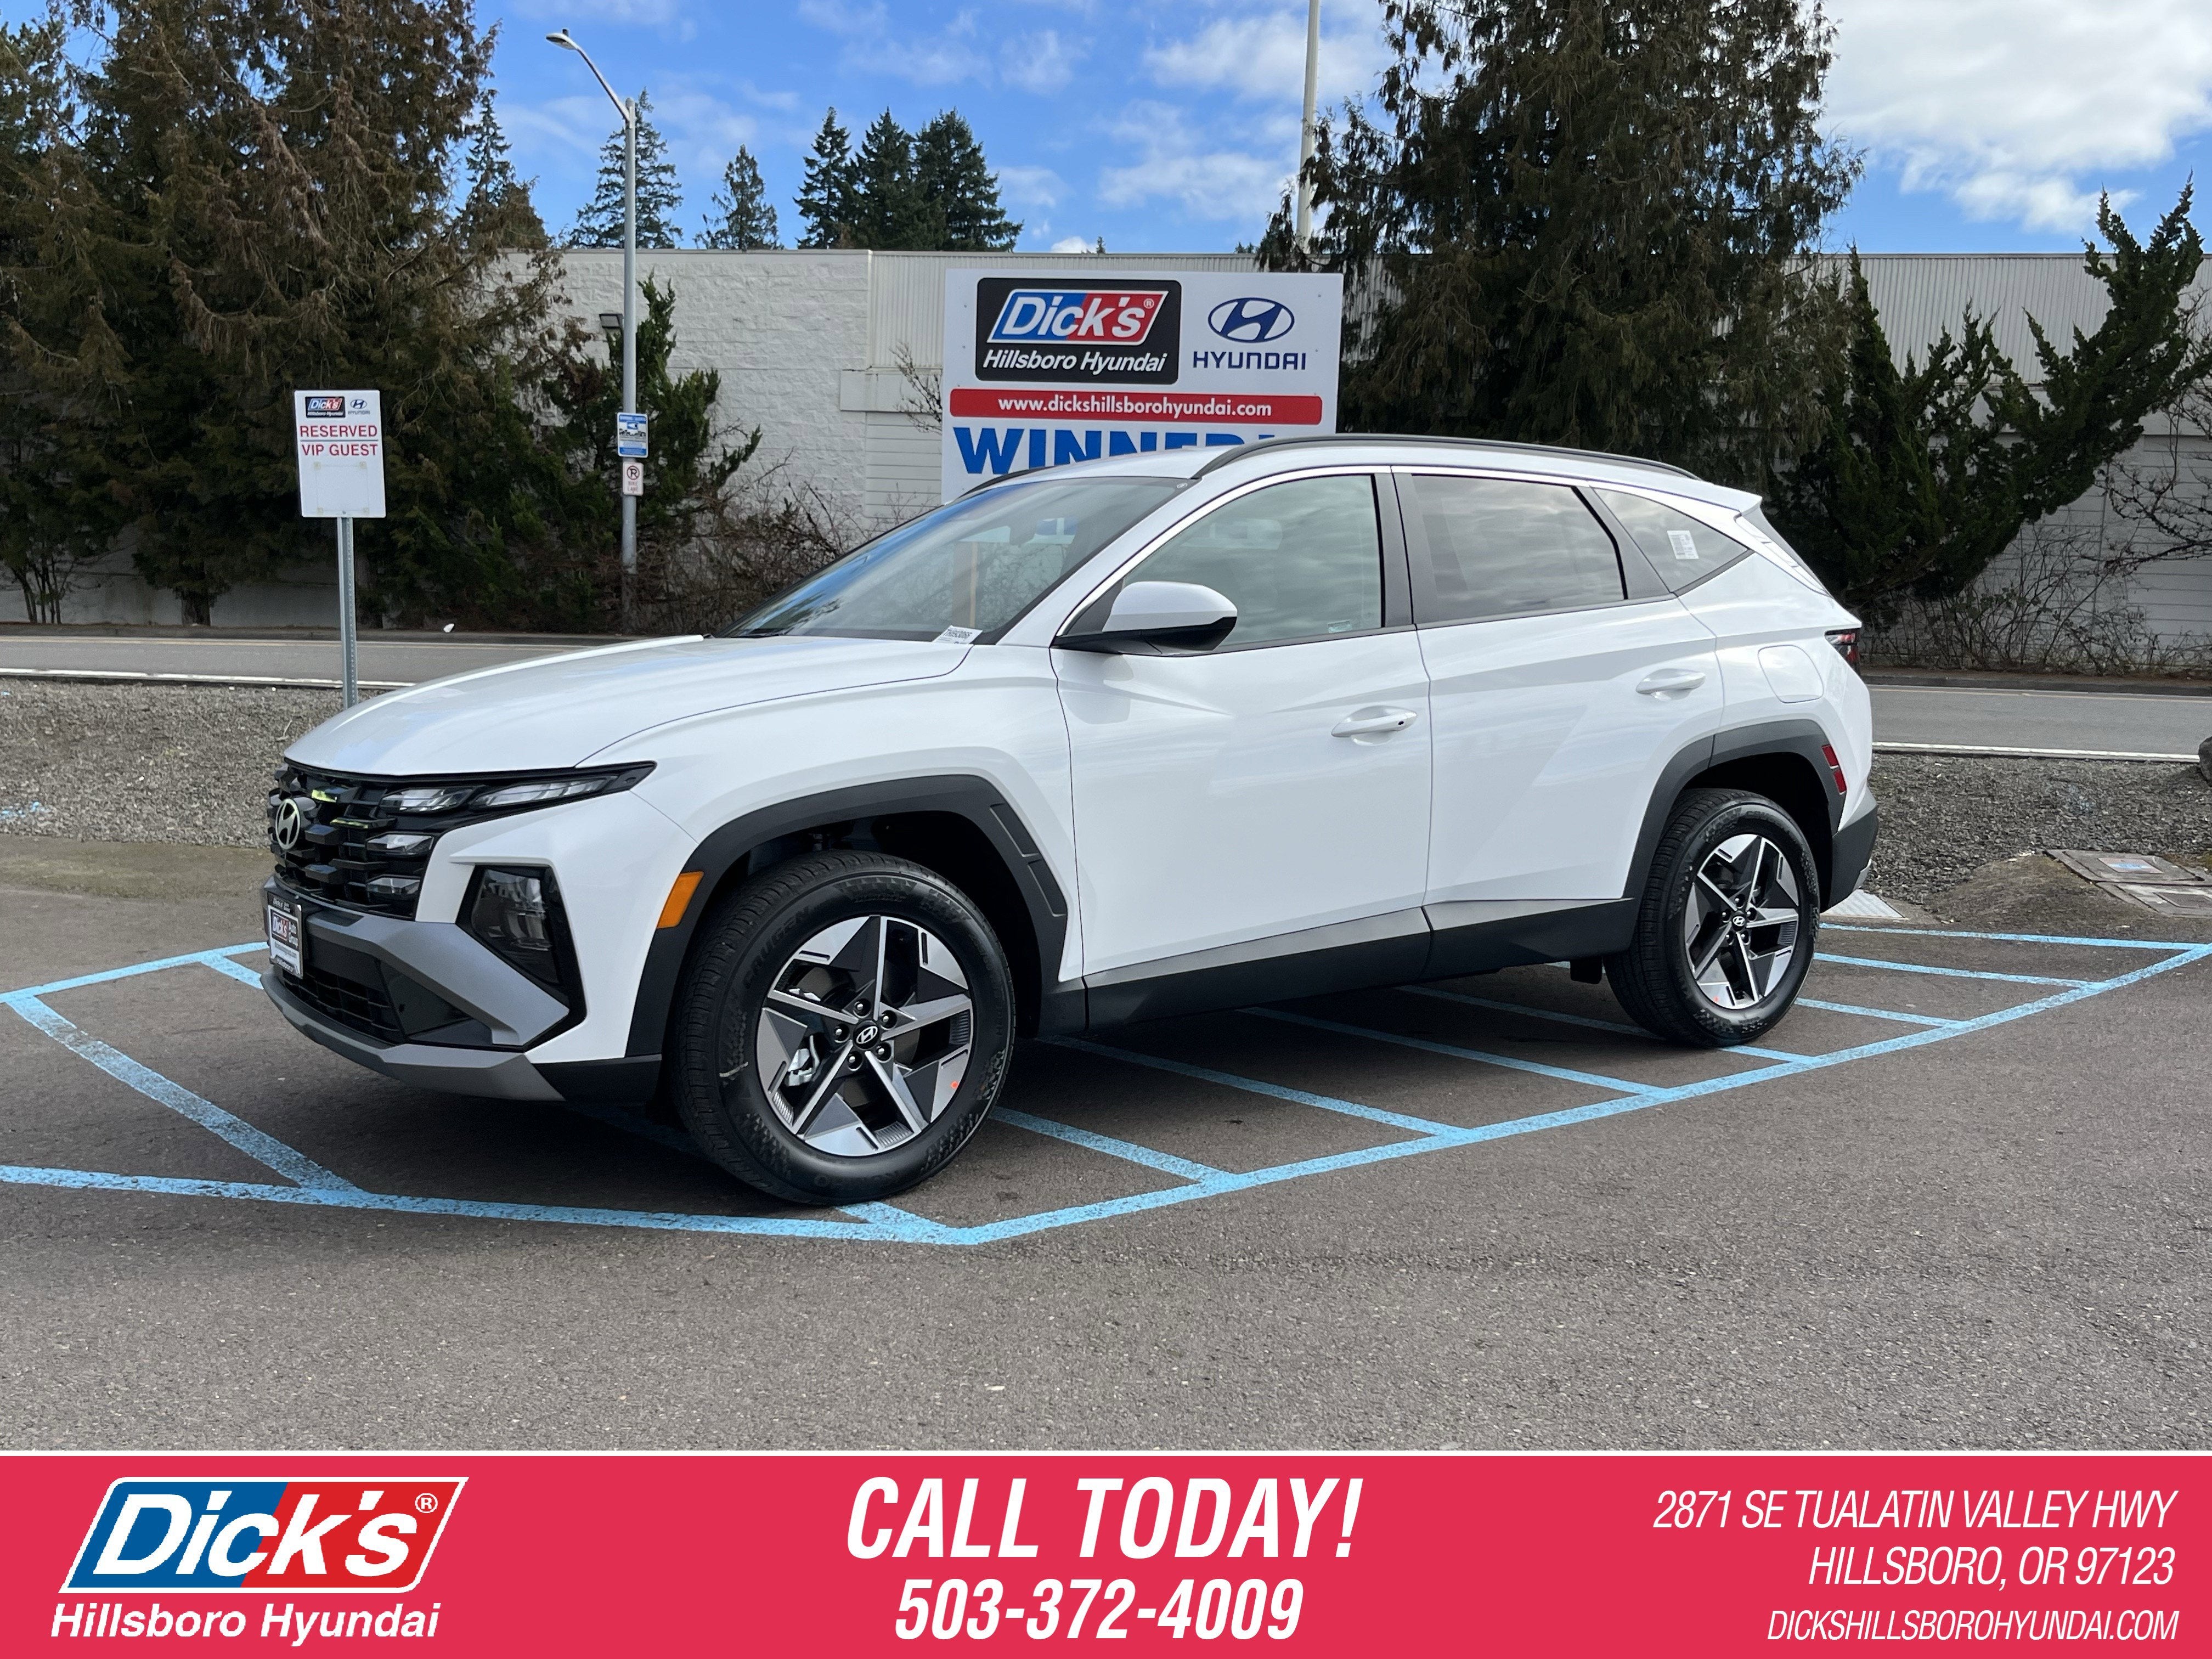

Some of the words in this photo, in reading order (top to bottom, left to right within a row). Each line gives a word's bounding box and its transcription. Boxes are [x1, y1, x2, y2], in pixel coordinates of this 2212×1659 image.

[1001, 295, 1146, 337] Dick's
[983, 349, 1077, 371] Hillsboro
[1079, 352, 1168, 375] Hyundai
[1193, 350, 1306, 371] HYUNDAI
[311, 399, 340, 409] Dick's
[998, 394, 1272, 419] www.dickshillsborohyundai.com
[300, 425, 377, 437] RESERVED
[302, 444, 324, 456] VIP
[329, 444, 378, 456] GUEST
